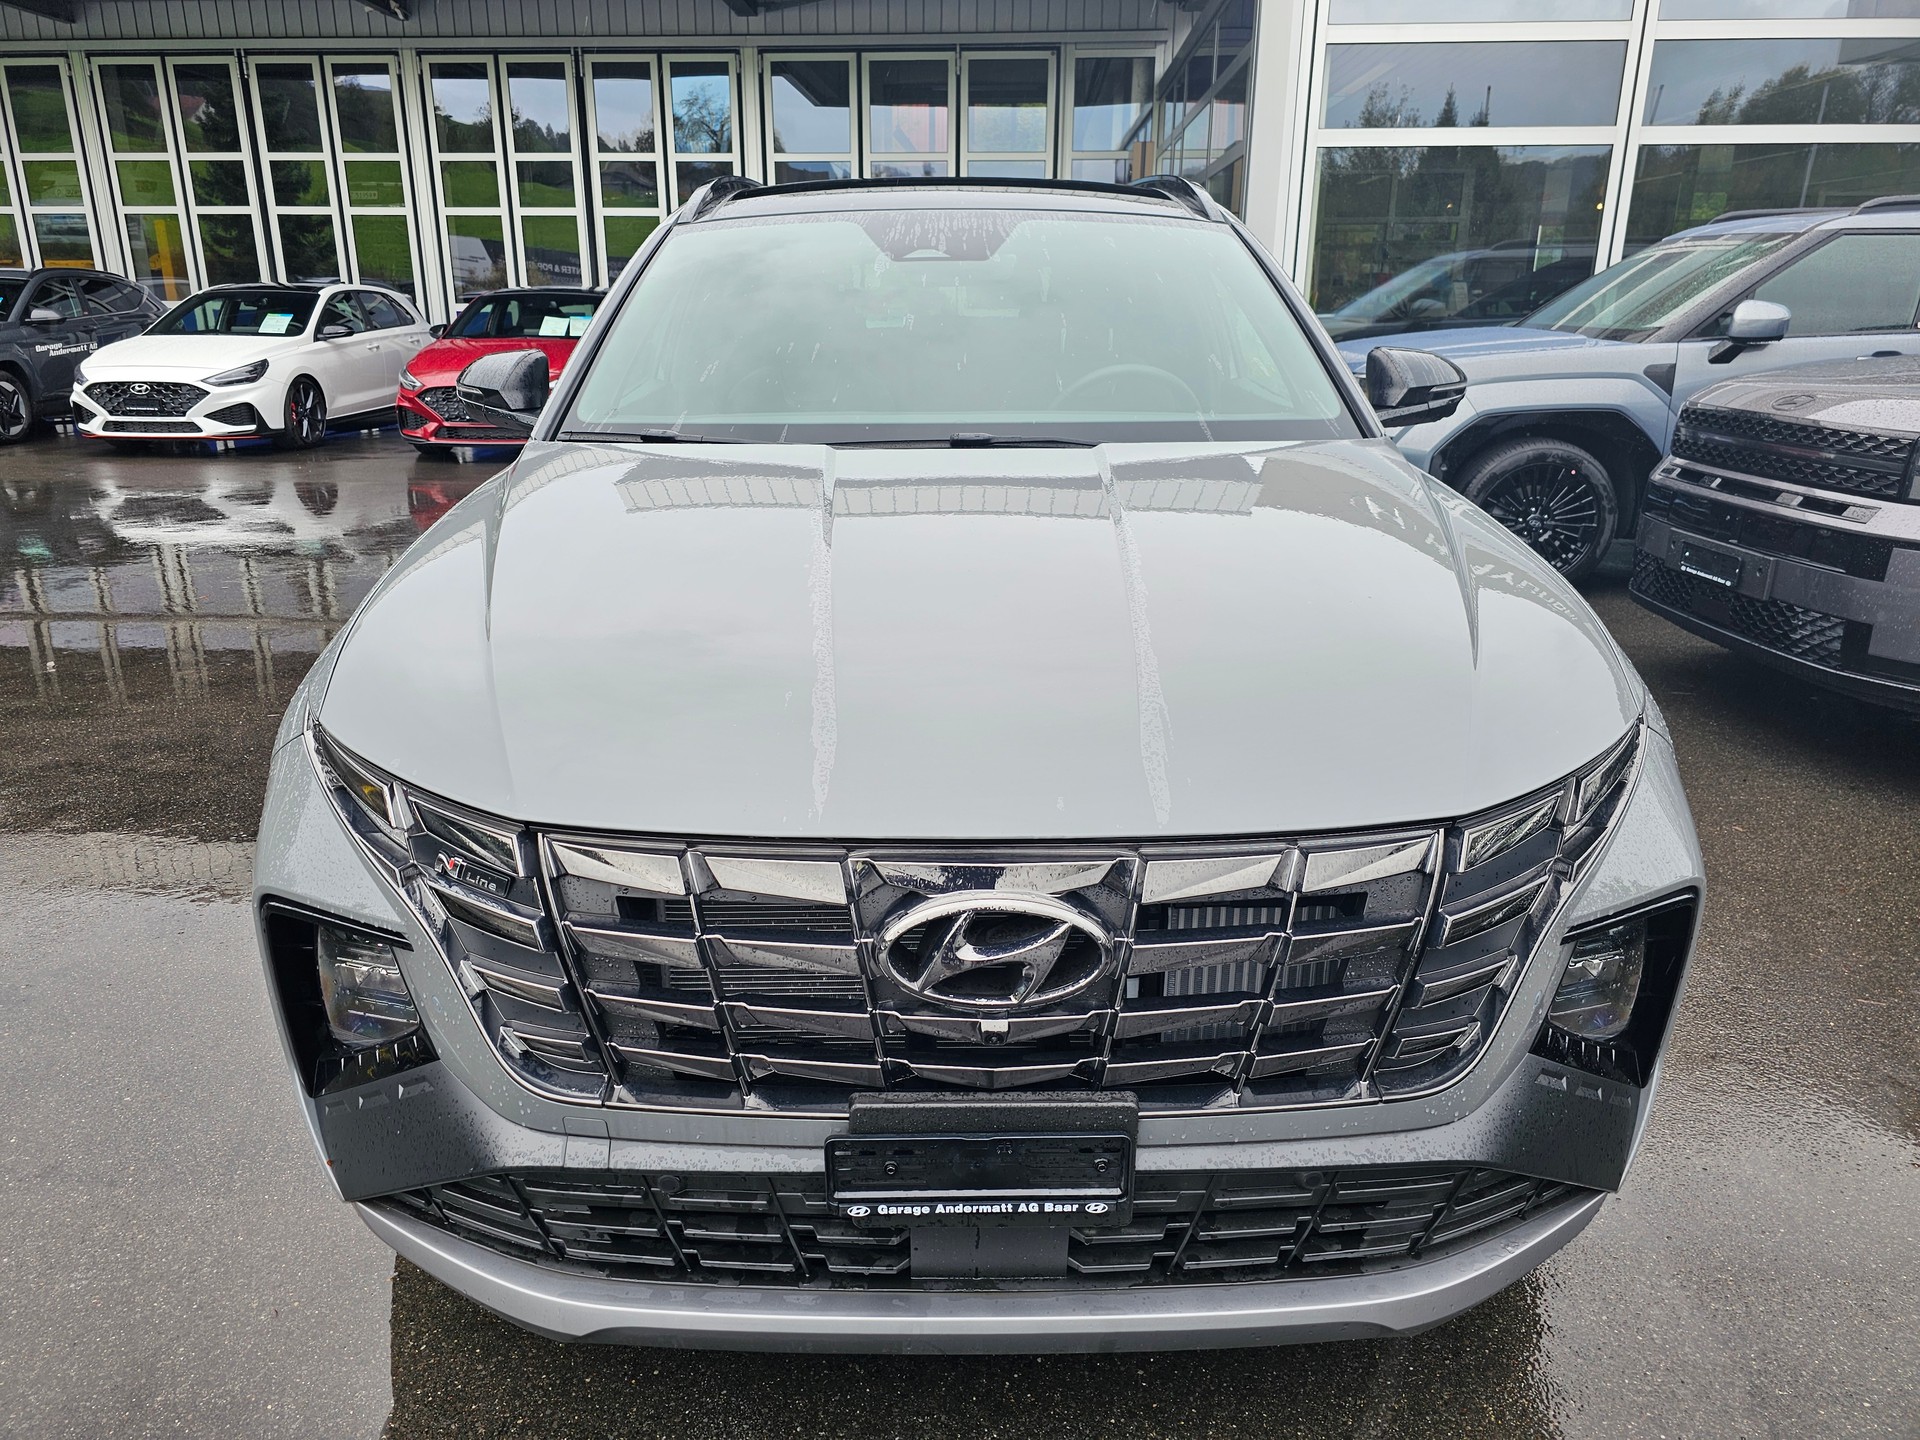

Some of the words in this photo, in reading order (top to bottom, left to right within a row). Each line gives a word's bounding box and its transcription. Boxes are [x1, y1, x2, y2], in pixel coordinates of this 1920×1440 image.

[35, 343, 63, 352] Garage
[49, 345, 88, 357] Andermatt
[466, 872, 497, 891] Line
[877, 1204, 931, 1216] Garage
[935, 1203, 1013, 1214] Andermatt
[1018, 1202, 1039, 1213] AG
[1044, 1202, 1079, 1213] Baar
